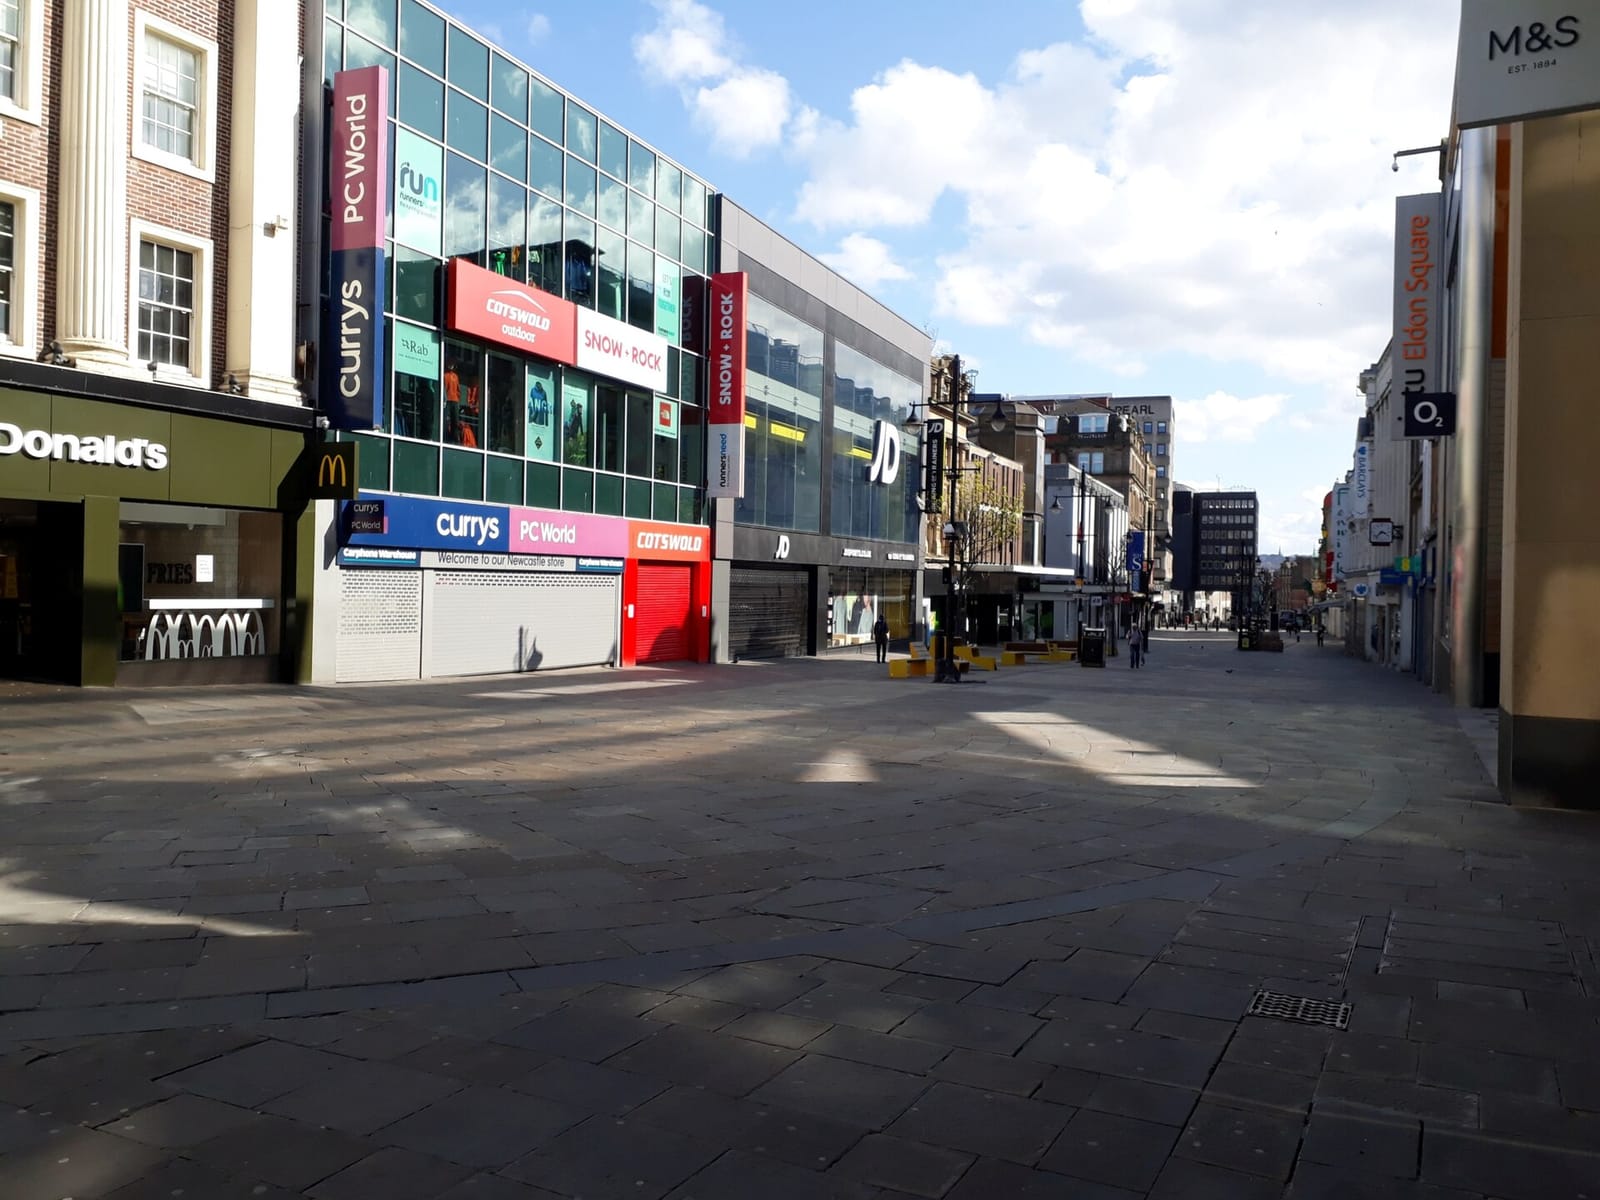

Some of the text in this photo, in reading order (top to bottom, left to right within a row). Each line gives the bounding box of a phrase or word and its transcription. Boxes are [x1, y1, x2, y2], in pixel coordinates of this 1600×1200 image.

[1489, 16, 1579, 60] M&S
[1508, 58, 1556, 74] EST. 1884
[344, 94, 366, 223] PC World
[400, 166, 437, 202] run
[1405, 215, 1434, 292] Square
[486, 298, 550, 331] COTSWOLD
[720, 292, 733, 339] ROCK
[1402, 299, 1427, 360] Eldon
[340, 280, 369, 398] currys
[410, 340, 428, 356] Rab
[502, 324, 536, 343] outdoor
[584, 329, 623, 359] SNOW
[631, 346, 661, 372] ROCK
[719, 354, 732, 405] SNOW
[1115, 404, 1155, 415] PEARL
[928, 422, 943, 433] JD
[719, 432, 728, 488] runnersneed
[869, 420, 900, 484] JD
[1357, 457, 1367, 498] BARCLAYS
[351, 520, 381, 529] PC World
[353, 504, 379, 513] currys
[436, 513, 499, 546] currys
[520, 520, 576, 544] PC World
[637, 531, 702, 552] COTSWOLD
[343, 547, 417, 560] Carphone Warehouse
[438, 551, 565, 567] Welcome to our Newcastle store
[775, 535, 790, 559] JD
[147, 562, 193, 584] FRIES
